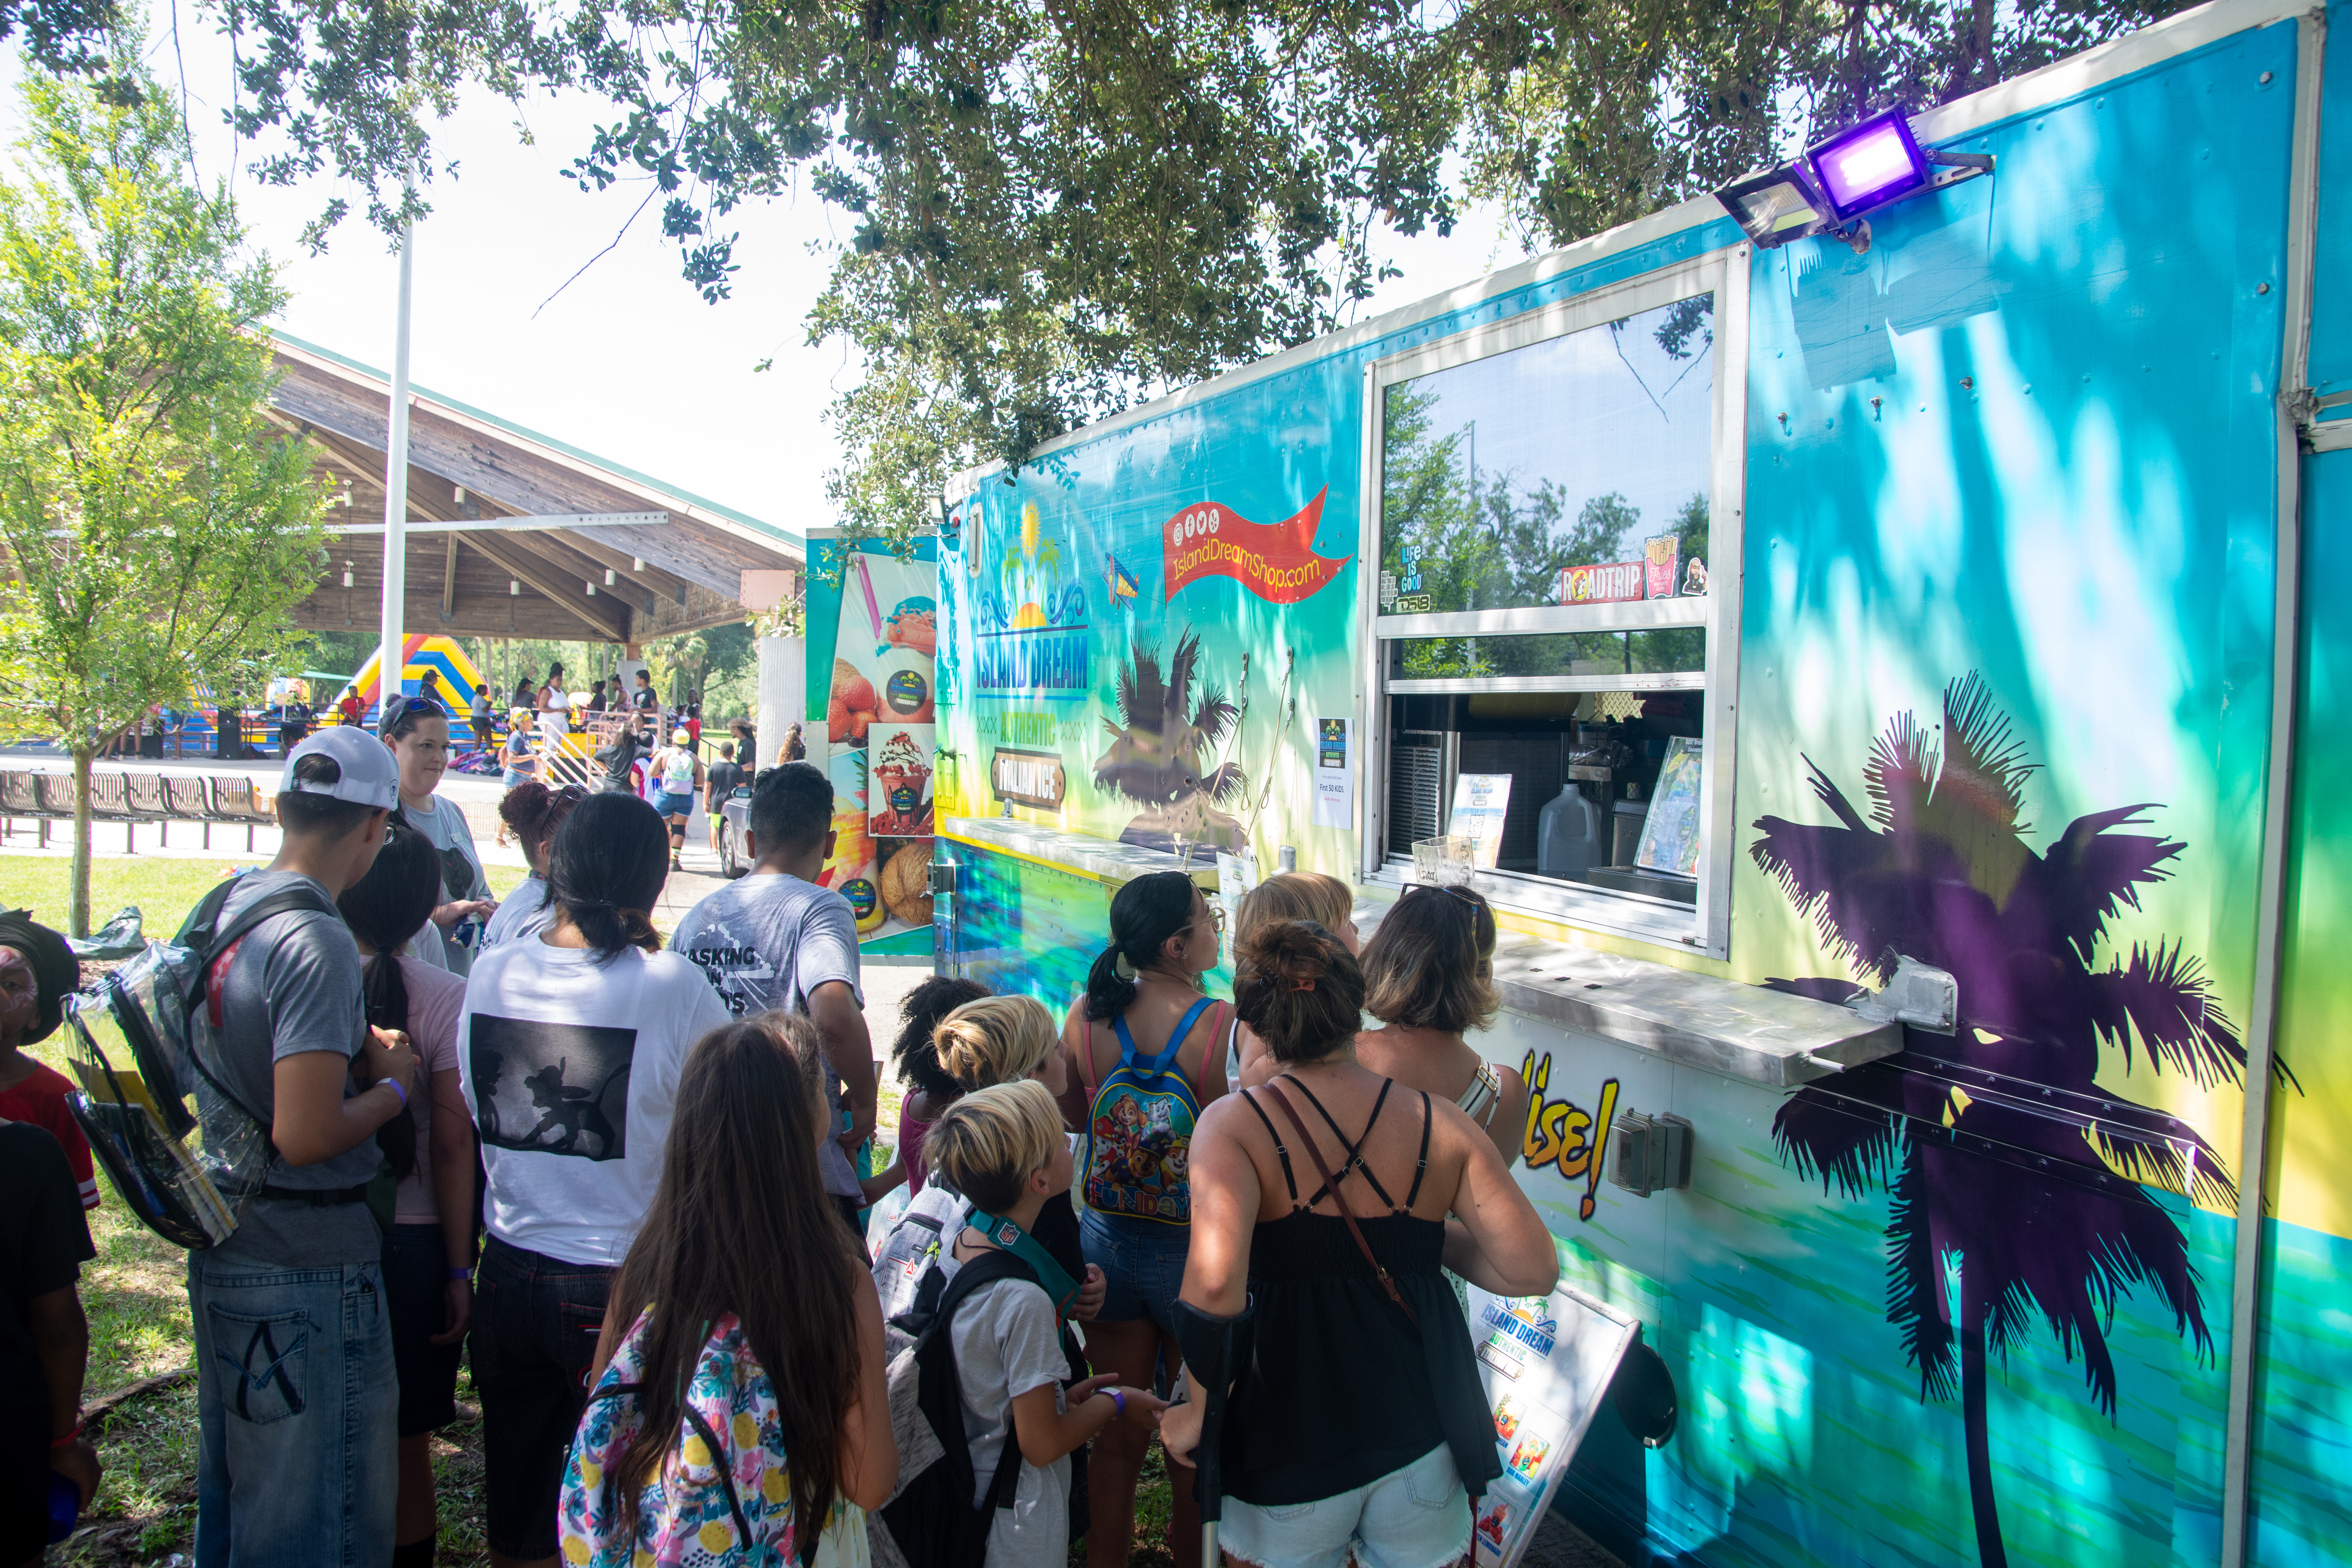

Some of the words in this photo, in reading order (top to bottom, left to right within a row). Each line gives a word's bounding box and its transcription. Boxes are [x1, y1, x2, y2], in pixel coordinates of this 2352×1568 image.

[1173, 538, 1320, 593] IslandDreamShop.com
[1408, 561, 1416, 576] IS
[1649, 566, 1671, 583] Fries
[1401, 574, 1422, 593] GOOD
[976, 640, 1027, 688] ISLAND
[1031, 636, 1088, 689] DREAM
[891, 684, 909, 693] ISLAND
[1000, 711, 1056, 747] AUTHENTIC
[1320, 741, 1333, 750] ISLAND
[1333, 742, 1346, 751] DREAM
[999, 759, 1036, 797] ITALIAN
[1038, 764, 1055, 800] ICE
[682, 946, 755, 966] ASKING
[706, 971, 721, 986] IN
[1001, 1230, 1014, 1242] NFL
[1481, 1303, 1519, 1335] ISLAND
[1515, 1323, 1555, 1357] DREAM
[1489, 1332, 1526, 1361] AUTHENTIC
[1497, 1437, 1509, 1449] REAM
[1506, 1466, 1515, 1477] BOB
[1514, 1472, 1530, 1486] MARLEY
[1481, 1538, 1502, 1557] LEMONADE
